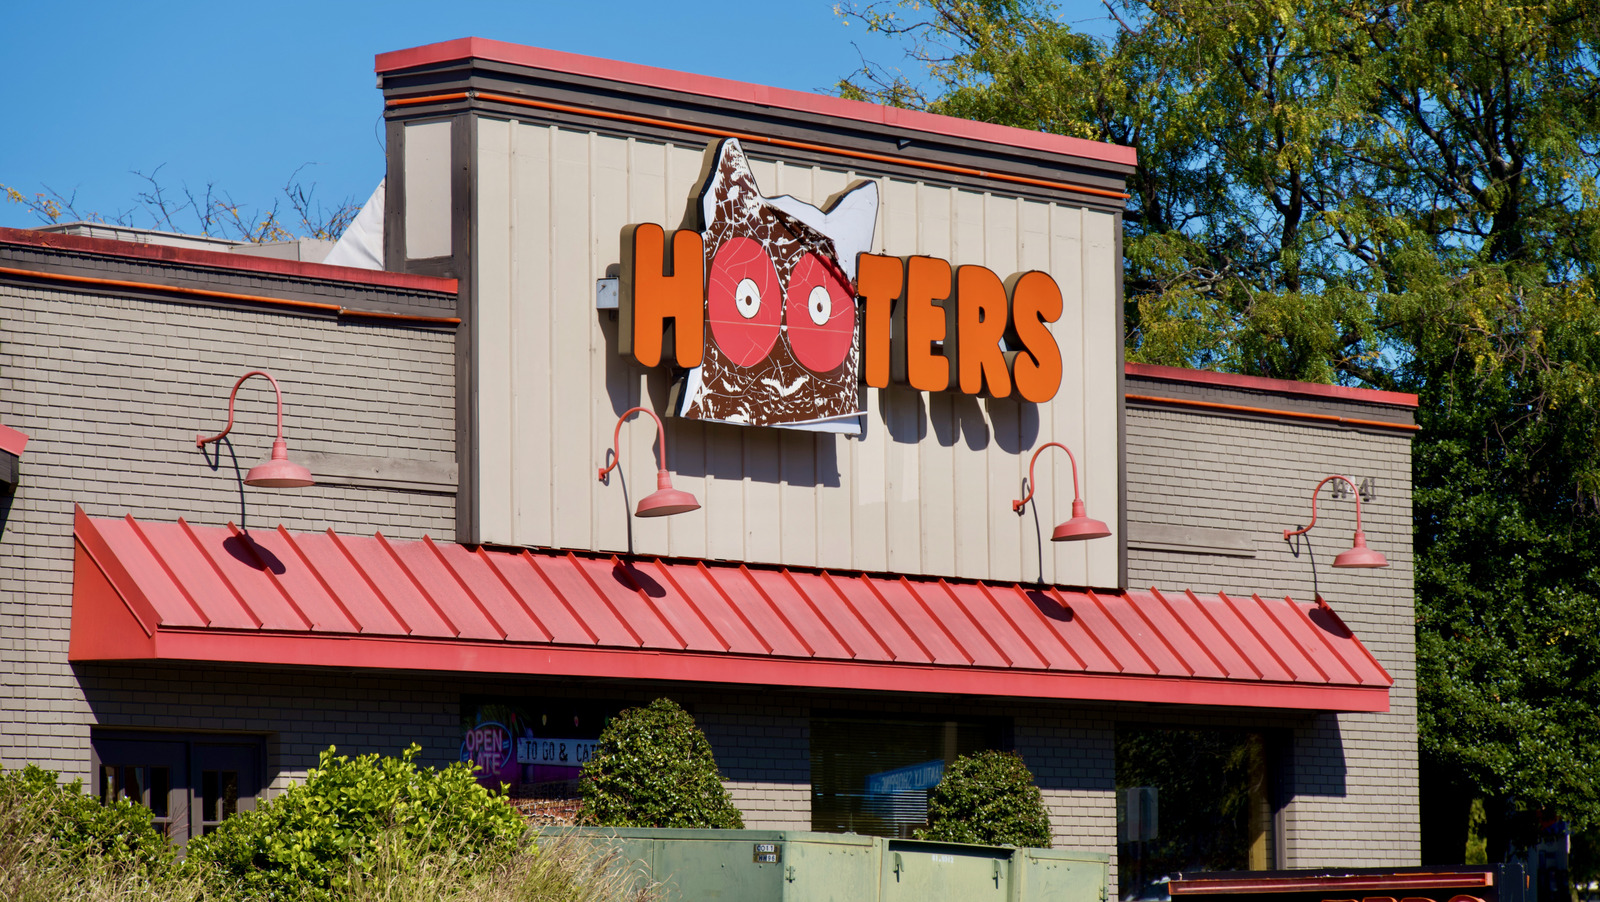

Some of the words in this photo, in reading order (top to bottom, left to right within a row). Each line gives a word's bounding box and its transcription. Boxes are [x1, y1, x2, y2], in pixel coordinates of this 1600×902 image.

[465, 728, 503, 752] OPEN
[526, 740, 538, 761] TO
[542, 741, 555, 762] GO
[558, 742, 569, 762] &
